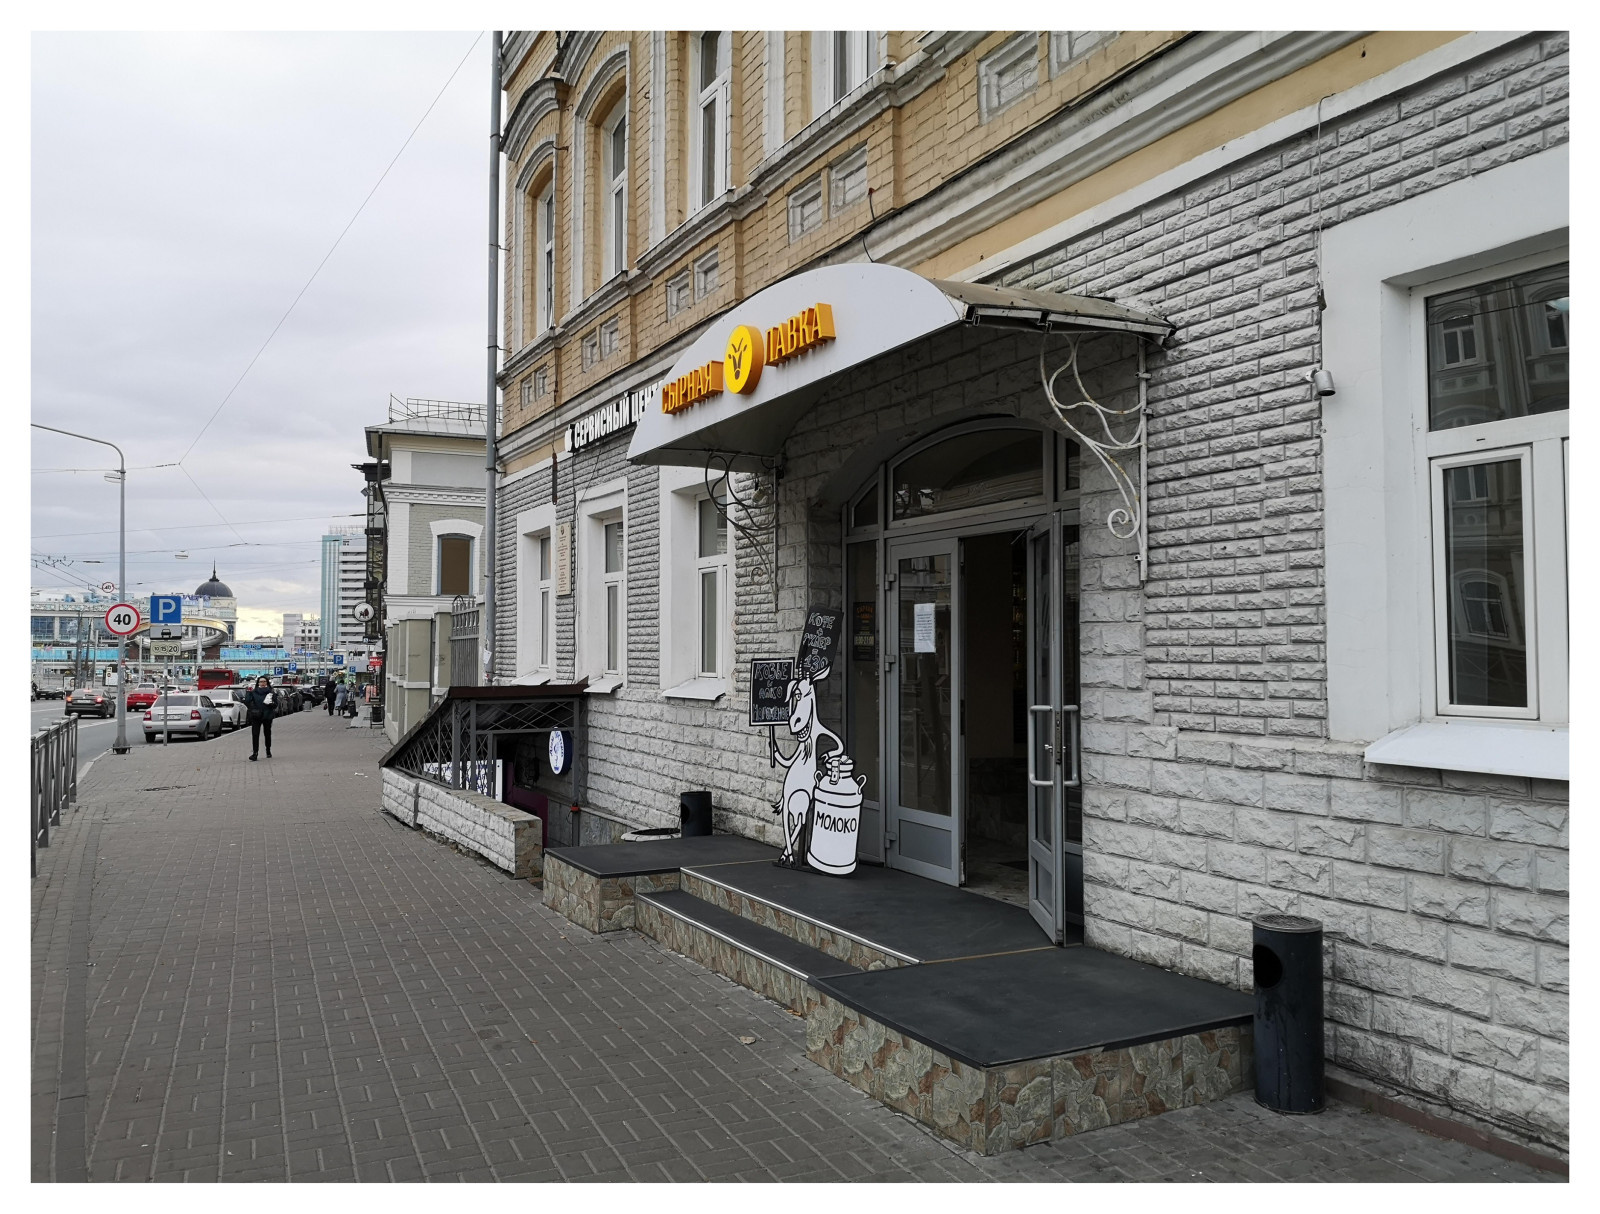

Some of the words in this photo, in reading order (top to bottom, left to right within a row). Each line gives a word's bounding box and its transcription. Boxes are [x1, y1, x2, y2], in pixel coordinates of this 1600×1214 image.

[661, 361, 719, 414] СЫРНАЯ
[764, 302, 831, 366] ЛАВКА
[573, 390, 630, 449] СЕРВИСНЫЙ
[113, 614, 132, 626] 40
[158, 598, 176, 621] P
[168, 645, 178, 653] 20
[815, 810, 857, 834] МОЛОКО
